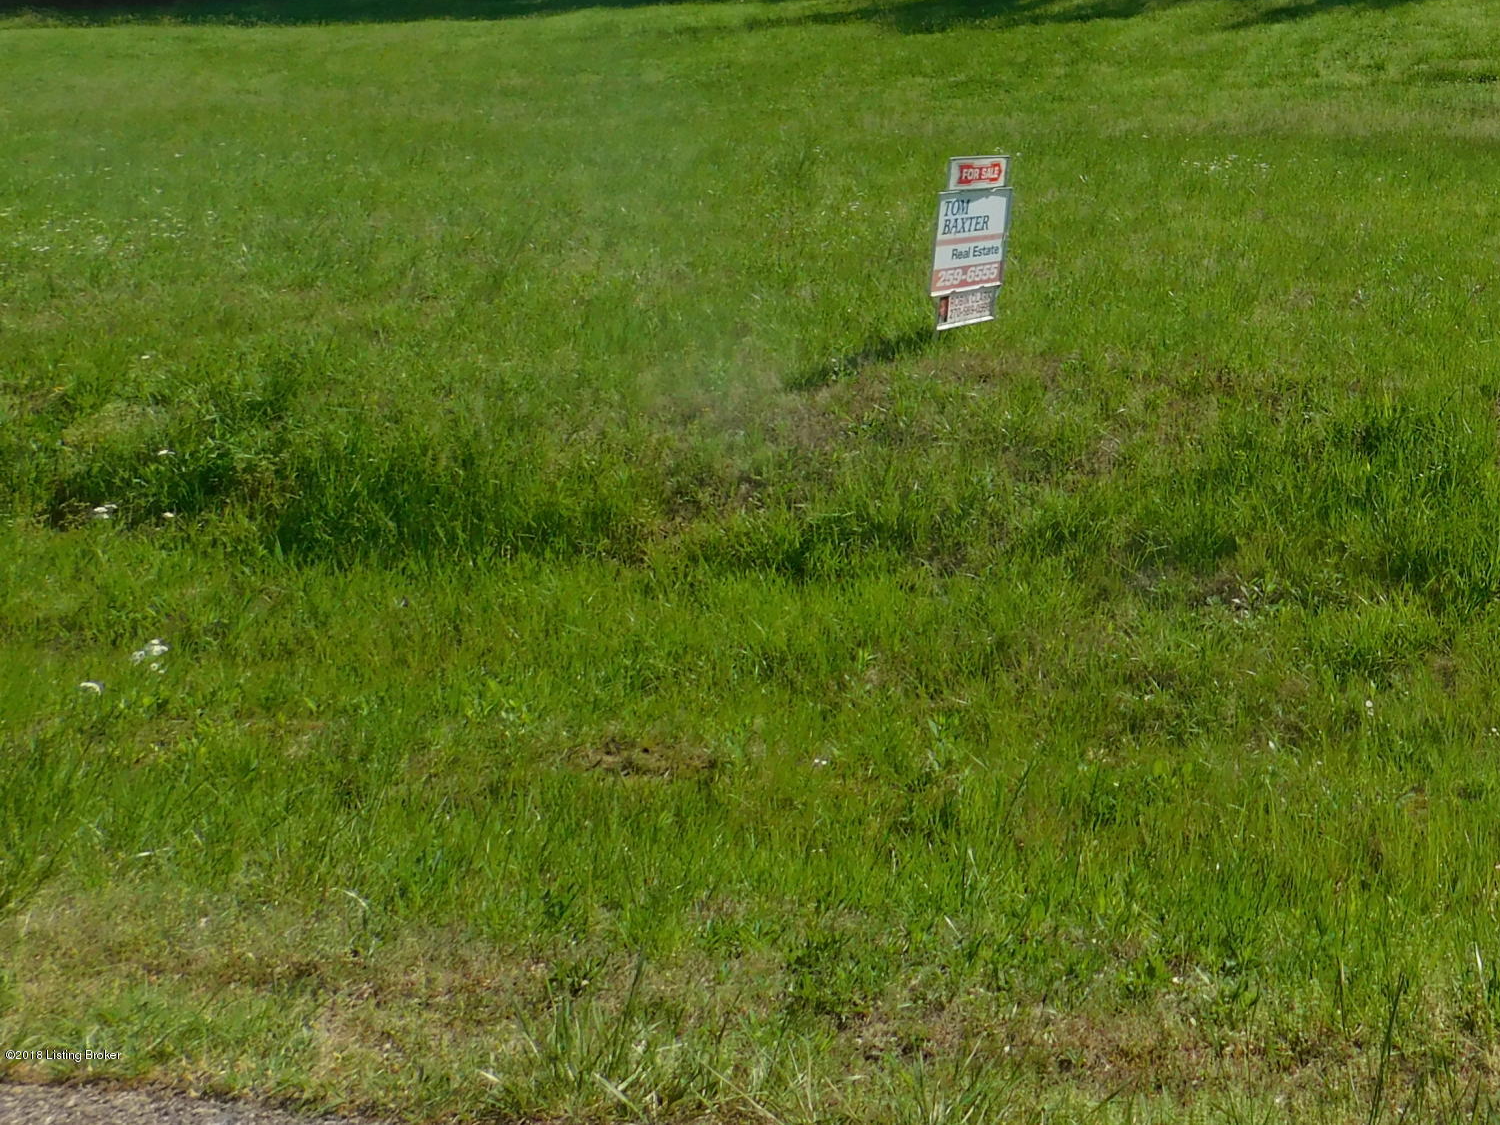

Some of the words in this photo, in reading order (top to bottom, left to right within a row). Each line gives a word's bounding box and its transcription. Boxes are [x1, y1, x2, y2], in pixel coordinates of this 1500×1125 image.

[962, 168, 980, 180] FOR
[981, 166, 999, 179] SALE
[944, 199, 970, 217] TOM
[942, 215, 990, 235] BAXTER
[951, 247, 970, 259] Real
[972, 245, 999, 257] Estate
[936, 264, 998, 287] 259-6555
